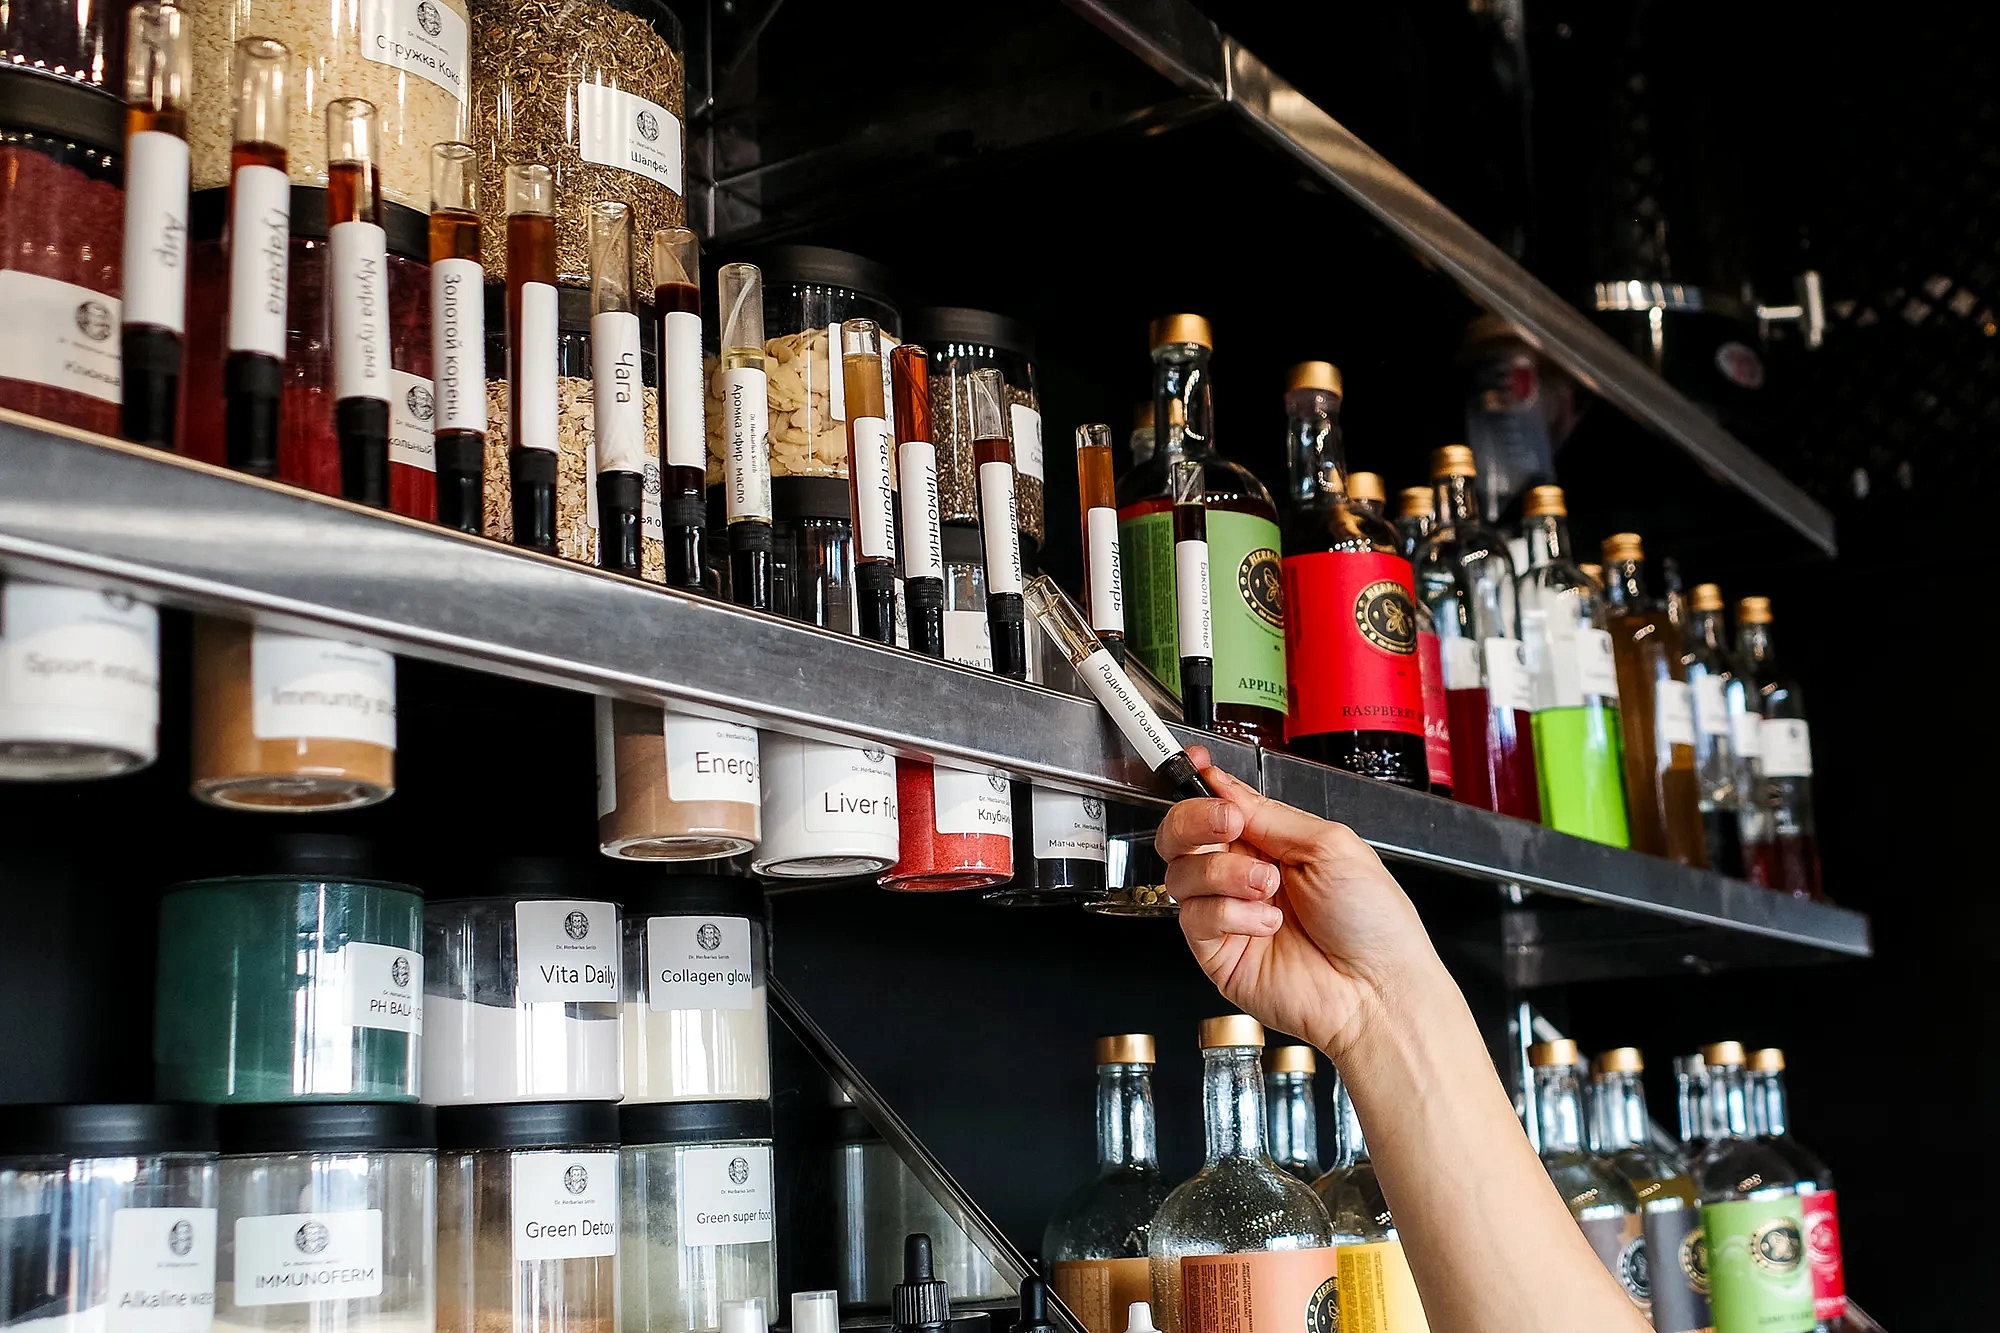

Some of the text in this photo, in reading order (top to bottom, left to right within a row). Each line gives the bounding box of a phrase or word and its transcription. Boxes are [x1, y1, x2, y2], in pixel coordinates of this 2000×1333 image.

[376, 34, 435, 69] Стружка
[630, 150, 668, 175] Шалфей
[152, 211, 186, 268] Аир
[354, 257, 378, 317] Муира
[442, 273, 463, 421] Золотой корень
[613, 352, 635, 403] Чага
[730, 383, 744, 429] Аромка
[735, 467, 745, 504] масло
[879, 432, 895, 551] Расторопша
[1202, 608, 1210, 649] Монье
[1238, 677, 1277, 695] APPLE
[1341, 705, 1416, 719] RASPBERRY
[1133, 709, 1171, 756] Розовая
[825, 792, 878, 815] Liver
[1049, 839, 1075, 848] Матча
[540, 964, 616, 990] Vita Daily
[661, 968, 751, 986] Collagen glow
[370, 999, 387, 1013] PH
[526, 1219, 615, 1239] Green Detox
[696, 1211, 731, 1225] Green
[732, 1210, 757, 1225] super
[256, 1267, 375, 1290] IMMUNOFERM
